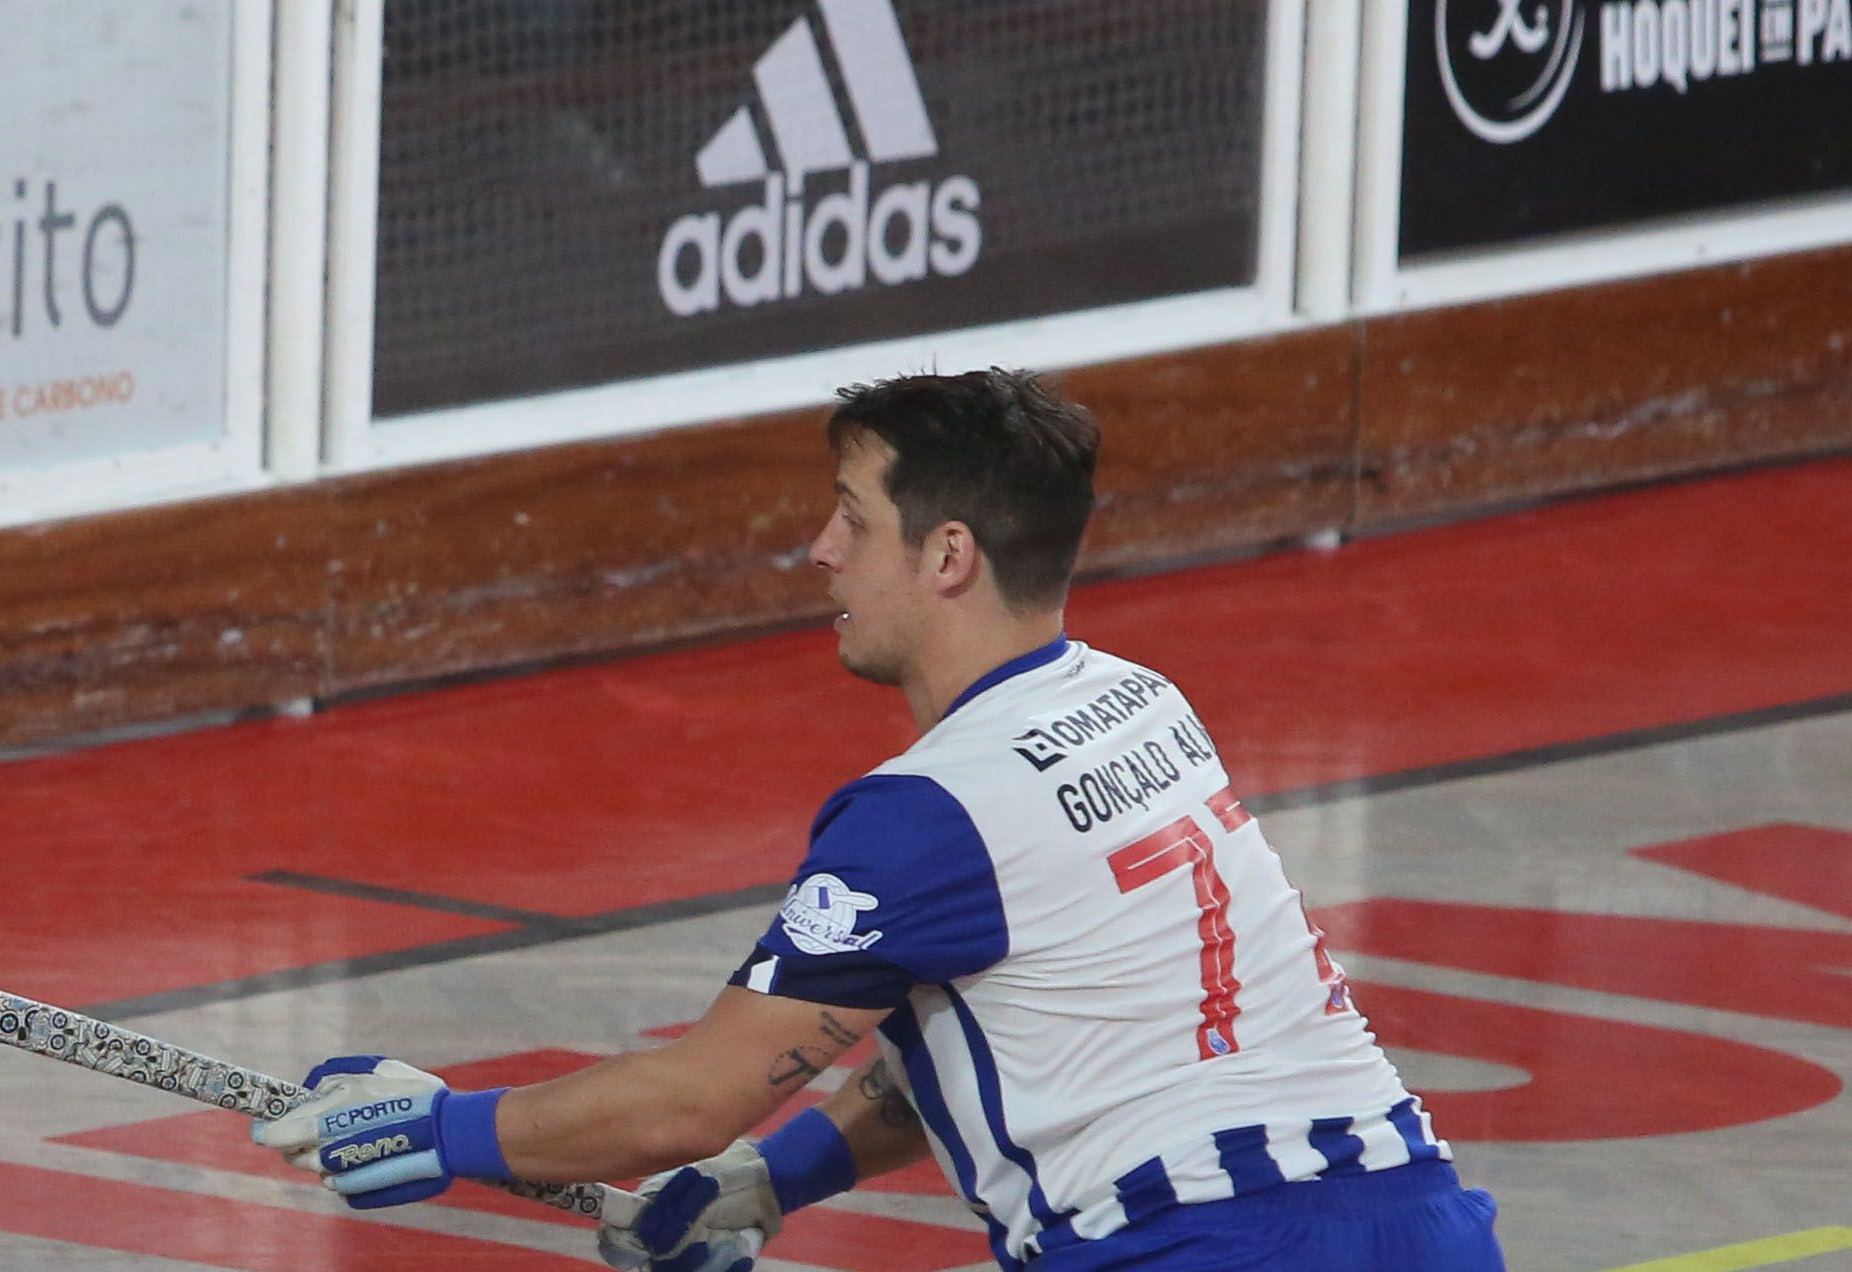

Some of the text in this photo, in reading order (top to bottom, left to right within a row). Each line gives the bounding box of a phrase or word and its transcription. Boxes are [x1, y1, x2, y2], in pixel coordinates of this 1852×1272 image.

[658, 160, 982, 316] adidas
[13, 369, 136, 419] CARBONO
[1051, 668, 1174, 746] OMATAPA
[1057, 740, 1181, 833] GONÇALO
[325, 1098, 412, 1132] FC PORTO
[329, 1134, 409, 1169] Reno
